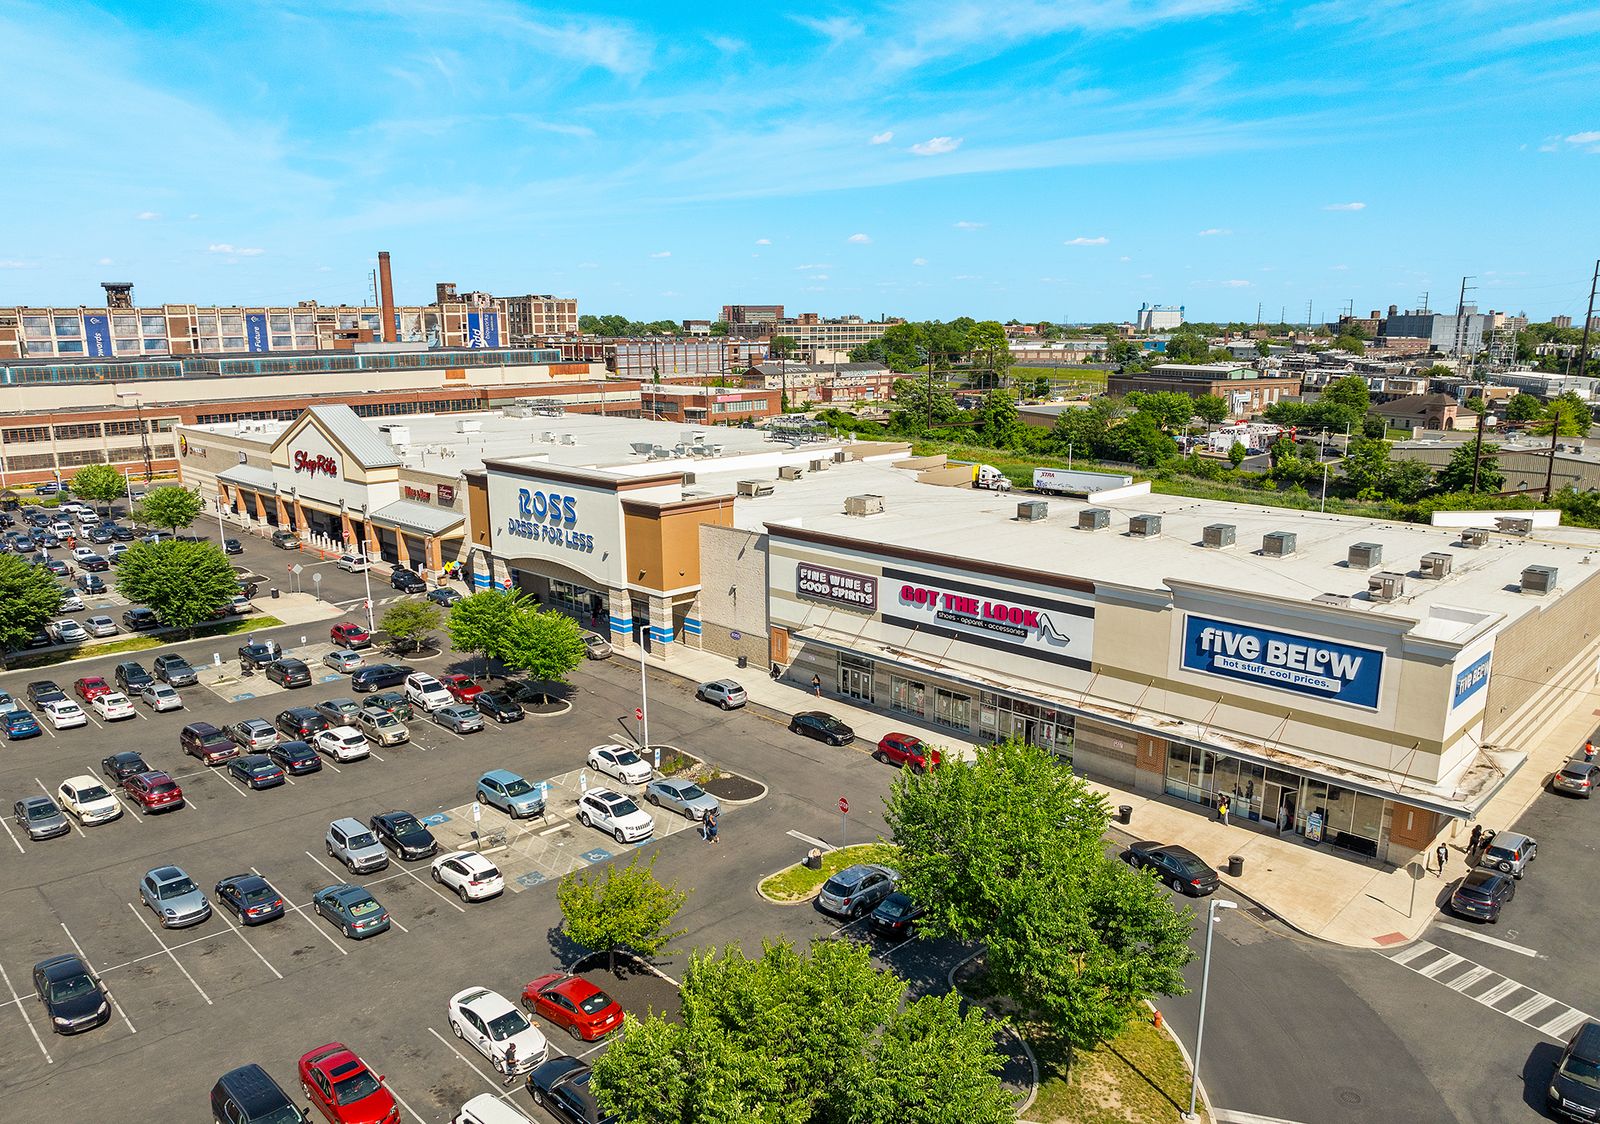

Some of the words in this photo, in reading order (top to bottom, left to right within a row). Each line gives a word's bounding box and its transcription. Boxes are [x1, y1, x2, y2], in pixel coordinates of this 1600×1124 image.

[472, 328, 481, 348] udd
[294, 450, 337, 478] ShopRite
[519, 488, 576, 522] ROSS
[508, 518, 540, 536] DRESS
[542, 525, 563, 542] FOR
[566, 531, 594, 549] LESS
[800, 569, 826, 582] FINE
[830, 574, 860, 590] WINE
[864, 583, 872, 593] &
[800, 580, 830, 594] GOOD
[832, 587, 873, 604] SPIRITS
[901, 585, 939, 607] GOT
[943, 593, 979, 616] THE
[984, 602, 1040, 628] LOOK
[938, 611, 956, 621] shoes
[961, 617, 984, 627] apparel
[988, 623, 1025, 636] accessories
[1201, 628, 1261, 660] five
[1223, 658, 1239, 669] hot
[1241, 662, 1266, 675] stuff.
[1270, 668, 1290, 679] cool
[1294, 673, 1329, 688] prices.
